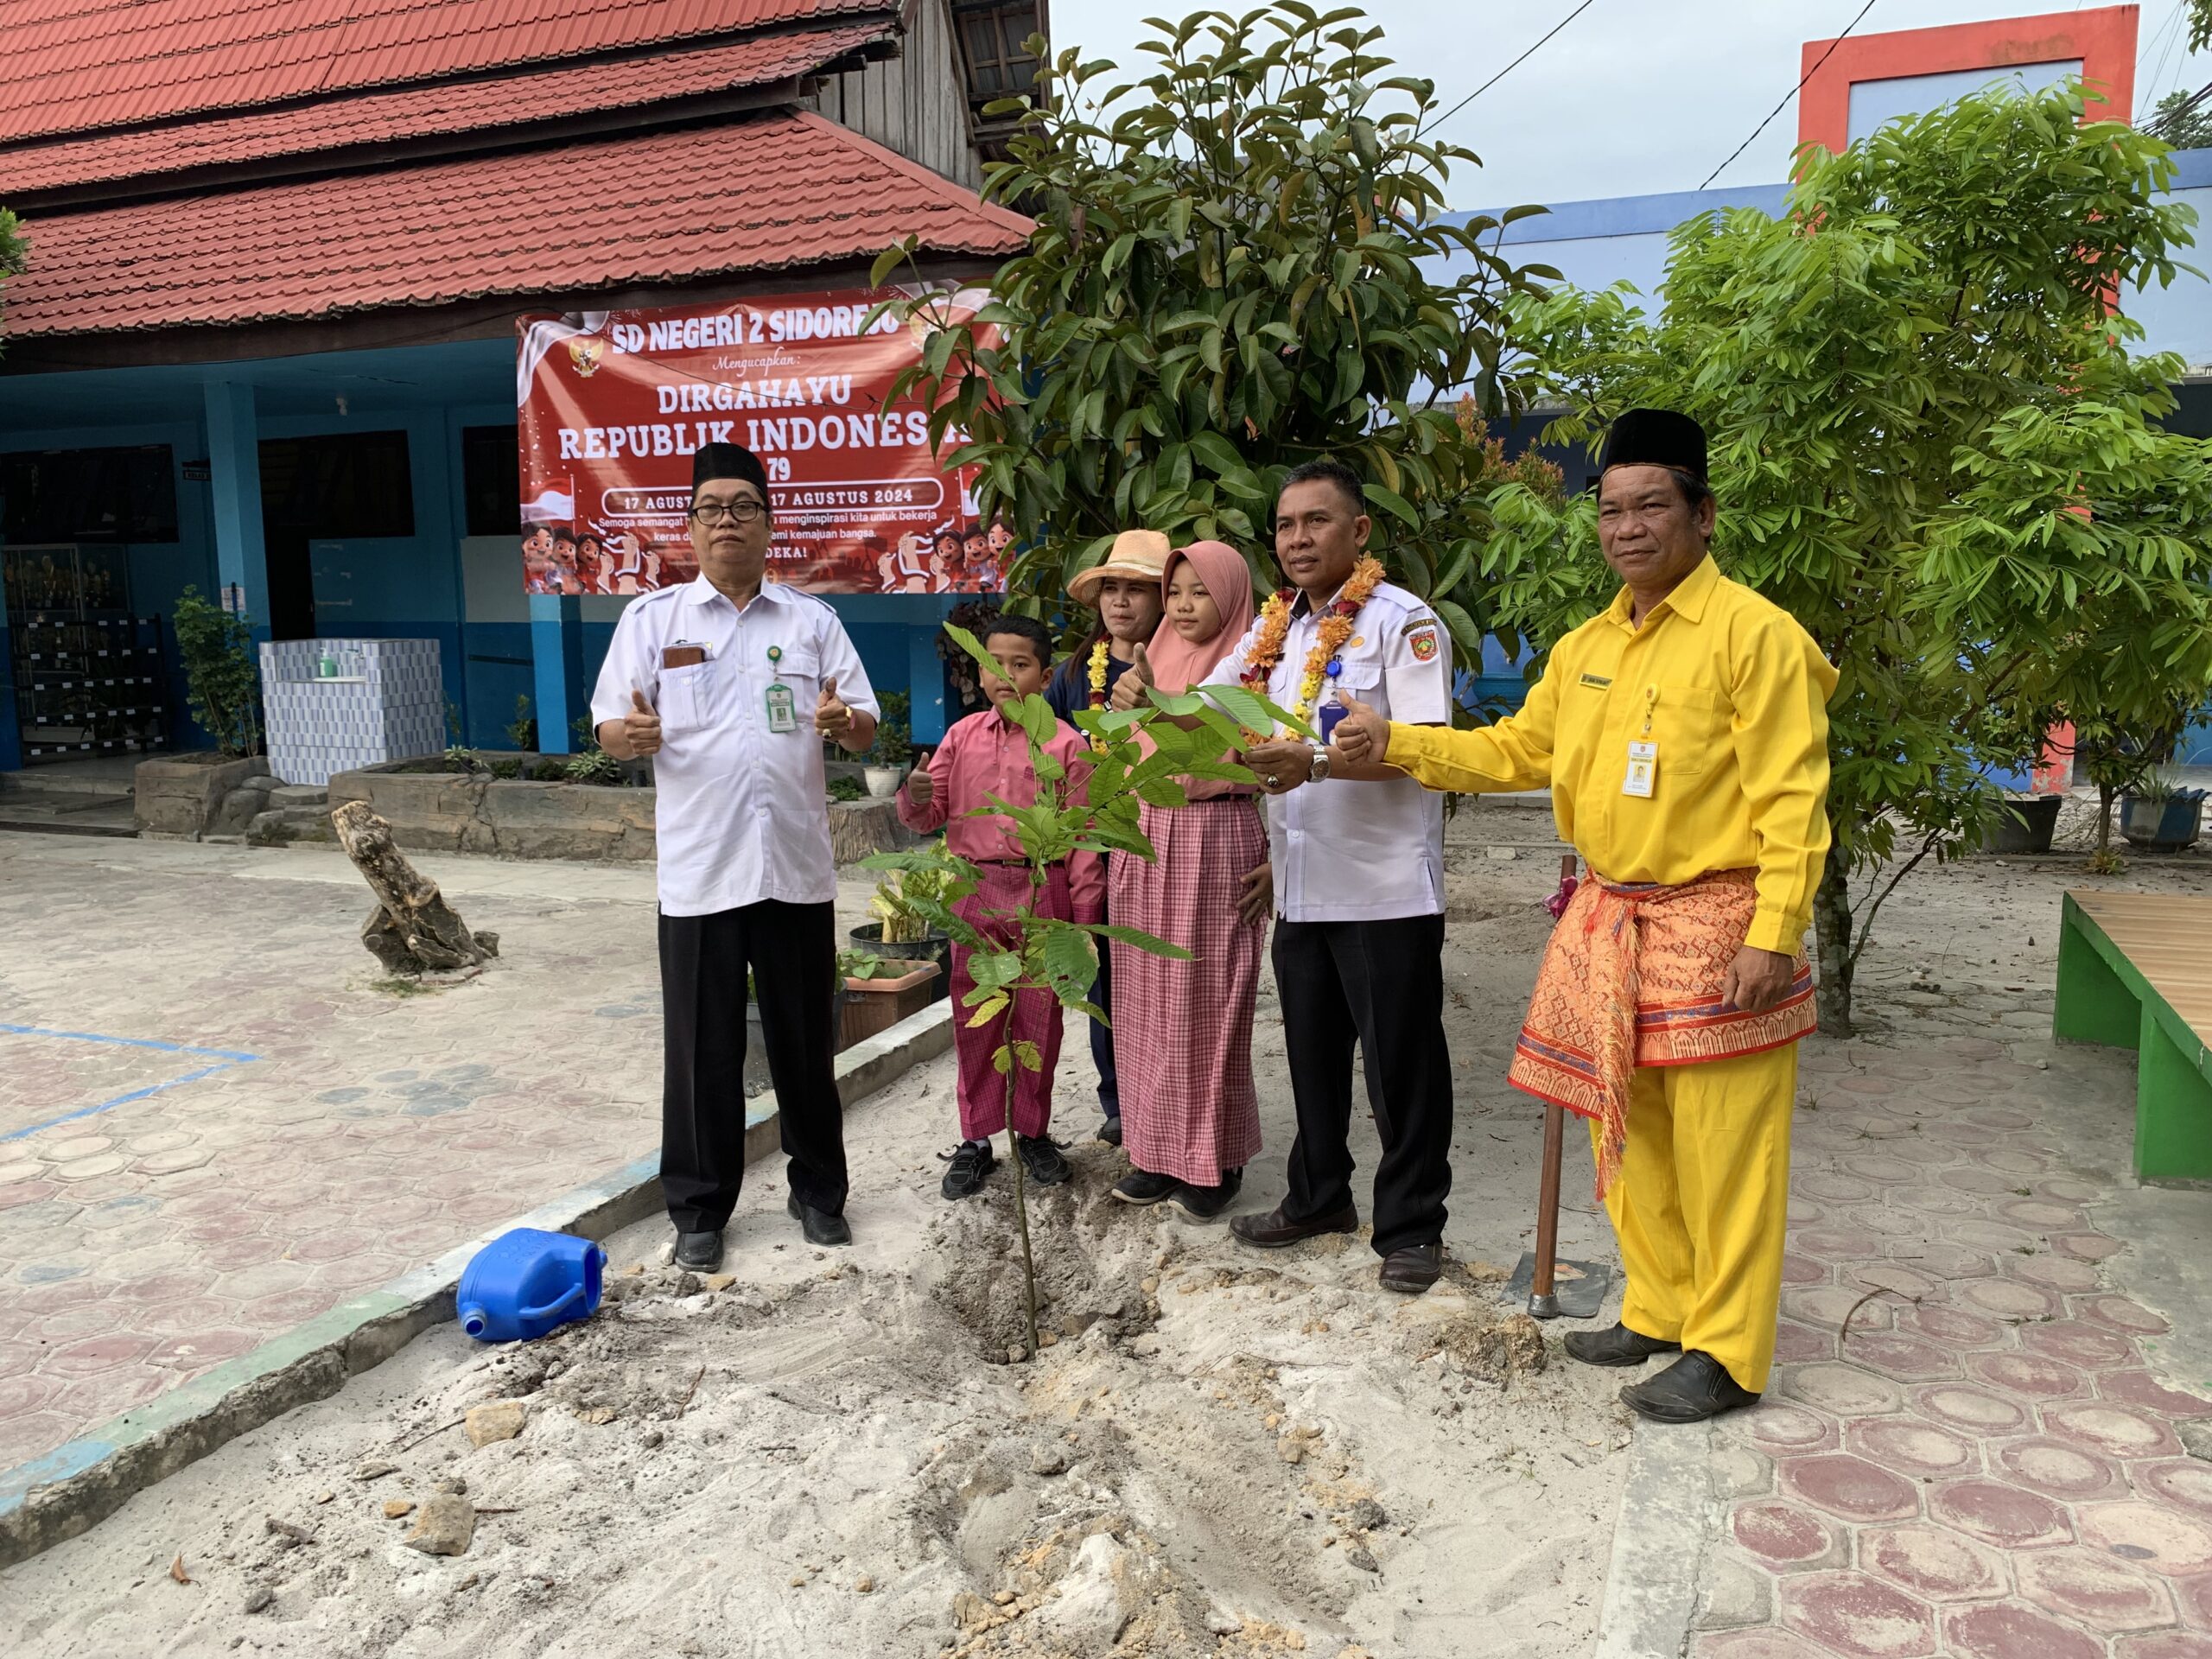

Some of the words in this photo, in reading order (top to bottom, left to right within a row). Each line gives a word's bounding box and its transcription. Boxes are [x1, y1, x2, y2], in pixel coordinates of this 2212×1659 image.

[612, 323, 645, 354] SD
[648, 314, 744, 352] NEGERI
[749, 312, 765, 344] 2
[712, 346, 801, 377] Mengucapkan:
[657, 374, 853, 414] DIRGAHAYU
[558, 420, 735, 460] REPUBLIK
[747, 410, 974, 453] INDONESA
[766, 457, 791, 481] 79
[624, 497, 640, 510] 17
[645, 495, 693, 510] AGUST
[771, 493, 785, 506] 17
[792, 490, 869, 505] AGUSTUS
[874, 489, 913, 504] 2024
[599, 518, 636, 530] Semoga
[637, 517, 683, 529] semangat
[779, 512, 849, 526] menginspirasi
[850, 512, 868, 523] kita
[870, 512, 898, 522] untuk
[899, 510, 938, 523] bekerja
[653, 531, 682, 542] keras
[790, 529, 838, 542] kemajuan
[839, 529, 877, 540] bangsa.
[765, 546, 807, 558] DEKA!
